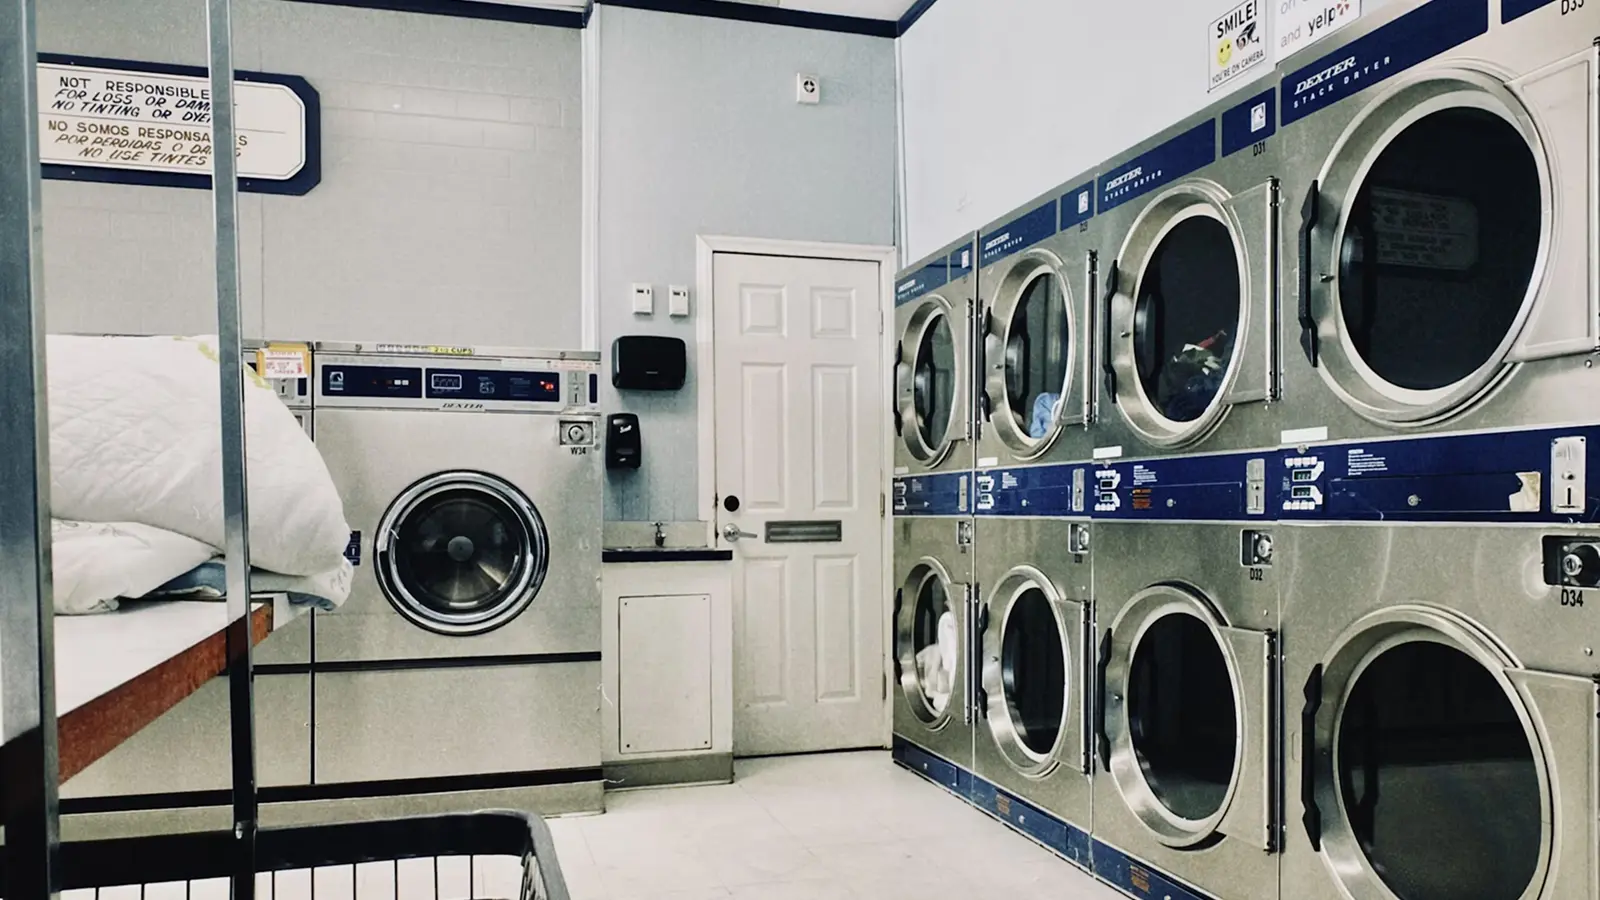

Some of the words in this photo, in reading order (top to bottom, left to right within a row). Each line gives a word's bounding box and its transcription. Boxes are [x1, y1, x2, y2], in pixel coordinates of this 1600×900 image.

[1217, 0, 1257, 39] SMILE!
[1280, 25, 1301, 48] and
[1308, 7, 1336, 37] yelp
[1212, 67, 1231, 83] YOU'RE
[1231, 62, 1241, 74] ON
[1241, 49, 1264, 68] CAMERA
[1294, 56, 1357, 95] DEXTER
[60, 76, 92, 89] NOT
[106, 80, 210, 100] RESPONSIBLE
[1293, 83, 1334, 109] STACK
[1343, 56, 1391, 85] DRYER
[55, 88, 88, 100] FOR
[92, 91, 133, 105] LOSS
[145, 95, 167, 108] OR
[51, 100, 75, 111] NO
[80, 101, 141, 118] TINTING
[152, 108, 172, 119] OR
[48, 120, 68, 132] NO
[76, 122, 130, 136] SOMOS
[138, 127, 248, 146] RESPONSAS
[54, 133, 89, 145] POR
[91, 136, 162, 151] PERDIDAS
[172, 142, 183, 153] O
[78, 147, 103, 158] NO
[109, 149, 144, 161] USE
[150, 152, 208, 166] TINTES
[1253, 141, 1266, 157] D31
[1105, 166, 1143, 192] DEXTER
[570, 447, 587, 455] W34
[1249, 568, 1263, 581] D32
[1560, 589, 1584, 608] D34
